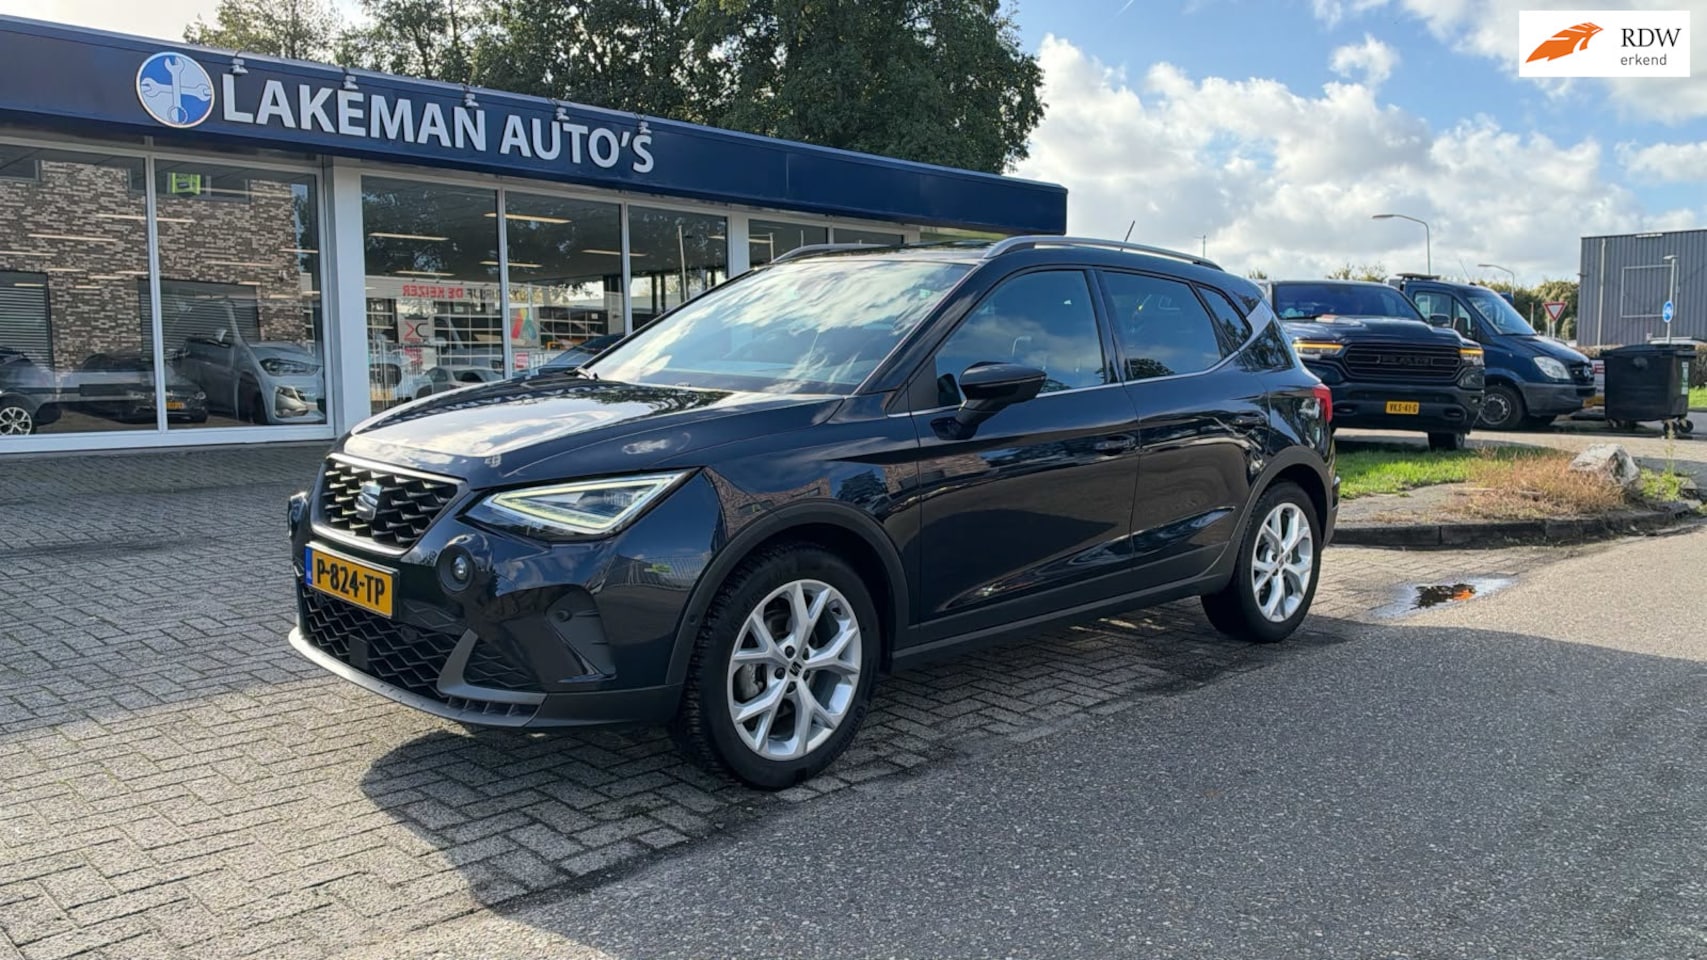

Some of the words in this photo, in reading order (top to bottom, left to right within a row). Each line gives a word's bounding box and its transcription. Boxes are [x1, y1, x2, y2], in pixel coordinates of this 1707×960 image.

[222, 73, 486, 152] LAKEMAN
[500, 114, 654, 173] AUTO'S
[316, 558, 386, 606] P-824-TP
